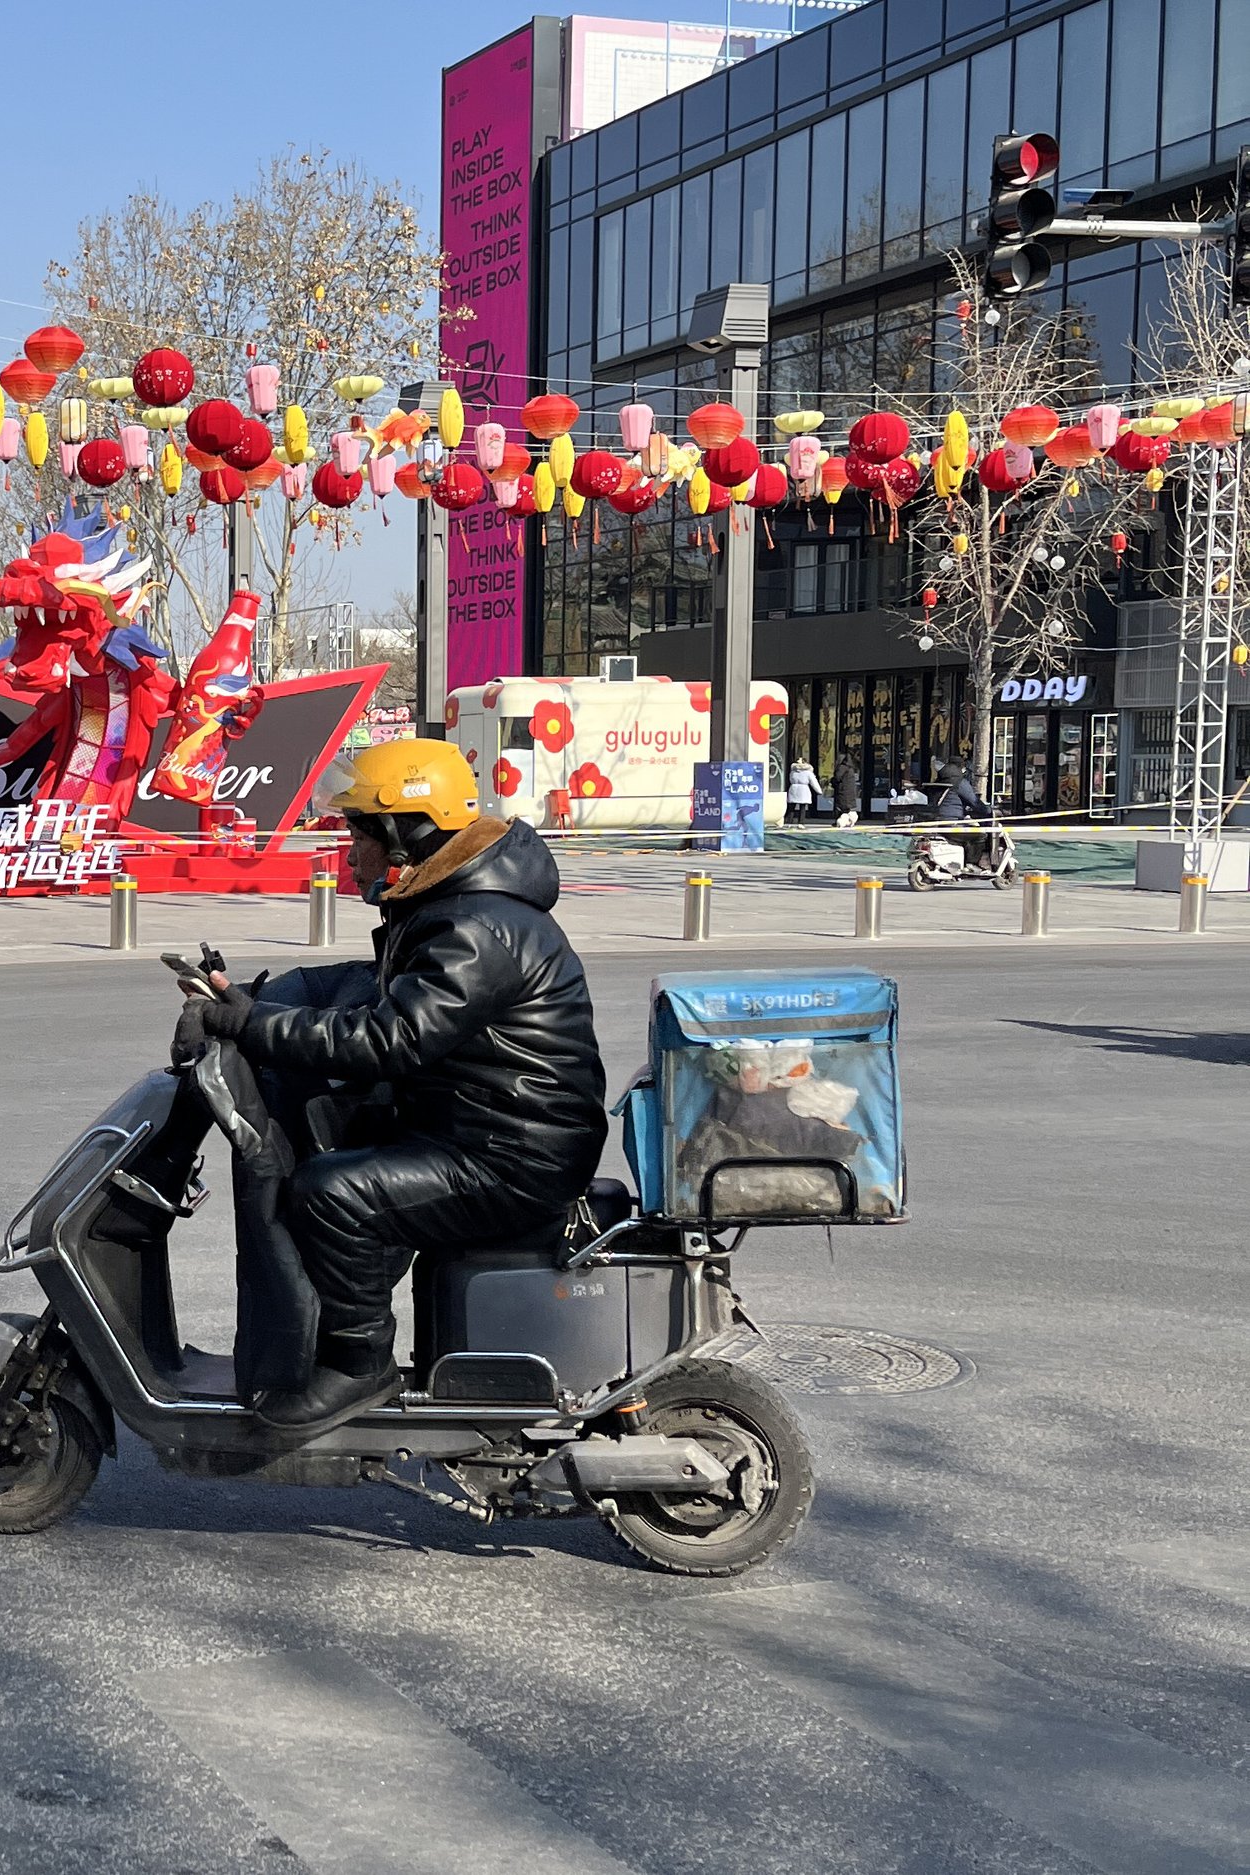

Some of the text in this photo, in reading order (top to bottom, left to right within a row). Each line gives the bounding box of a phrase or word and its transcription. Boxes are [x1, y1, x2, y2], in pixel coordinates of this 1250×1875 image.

[452, 125, 492, 162] PLAY
[451, 148, 504, 190] INSIDE
[450, 167, 522, 216] THE BOX
[471, 203, 522, 242] THINK
[450, 233, 521, 278] OUTSIDE
[450, 261, 521, 305] THE BOX
[449, 513, 479, 537] THE
[469, 542, 517, 568] THINK
[448, 570, 516, 598] OUTSIDE
[448, 598, 516, 624] THE BOX
[1000, 675, 1088, 702] DDAY
[605, 720, 701, 752] gulugulu
